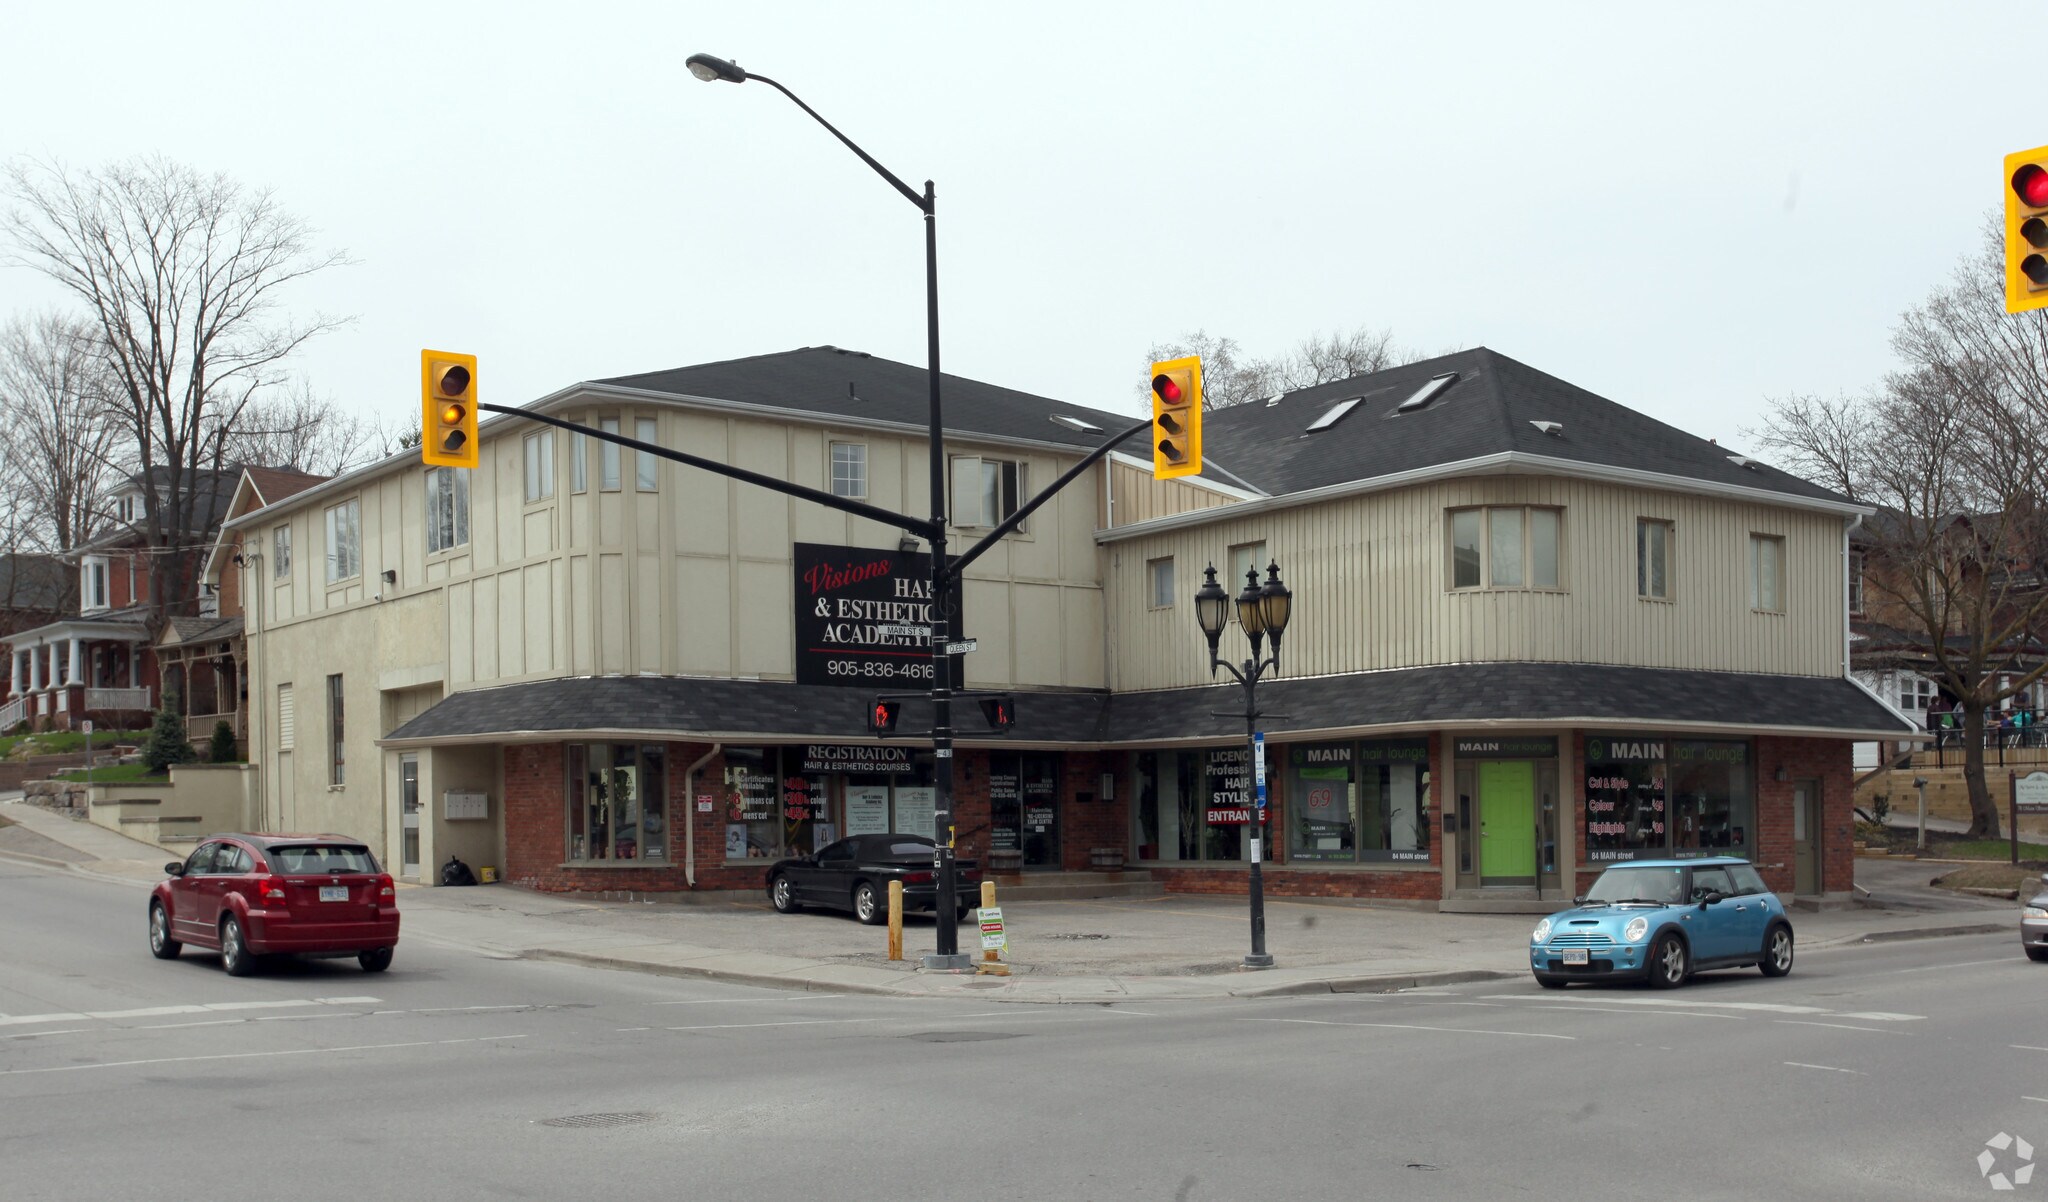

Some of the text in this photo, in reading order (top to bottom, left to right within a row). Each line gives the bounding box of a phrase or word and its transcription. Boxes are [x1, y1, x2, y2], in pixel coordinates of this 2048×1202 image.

[804, 559, 892, 595] Visions
[894, 577, 932, 599] HAI
[815, 597, 932, 623] & ESTHETIC
[887, 626, 924, 636] MAIN ST S
[949, 643, 972, 653] QUEEN ST
[827, 660, 933, 679] 905-836-4616
[808, 745, 907, 761] REGISTRATION
[1459, 742, 1500, 752] MAIN
[1211, 750, 1249, 762] LICENC
[1307, 746, 1426, 762] MAIN hair lounge
[1611, 742, 1744, 765] MAIN hair lounge
[804, 761, 911, 771] HAIR & ESTHETICS COURSES
[740, 775, 774, 783] Certificates
[1588, 776, 1602, 789] Cut
[1603, 776, 1610, 789] &
[1610, 777, 1629, 792] Style
[765, 796, 775, 805] cut
[810, 795, 827, 805] colour
[1213, 792, 1249, 803] STYLIS
[1308, 787, 1331, 809] 69
[1588, 799, 1615, 812] Colour
[743, 812, 758, 820] mens
[758, 811, 768, 820] cut
[1207, 809, 1265, 822] ENTRANE
[1588, 821, 1626, 836] Highlights
[1392, 852, 1429, 860] 84 MAIN street
[1591, 851, 1634, 860] 84 MAIN street
